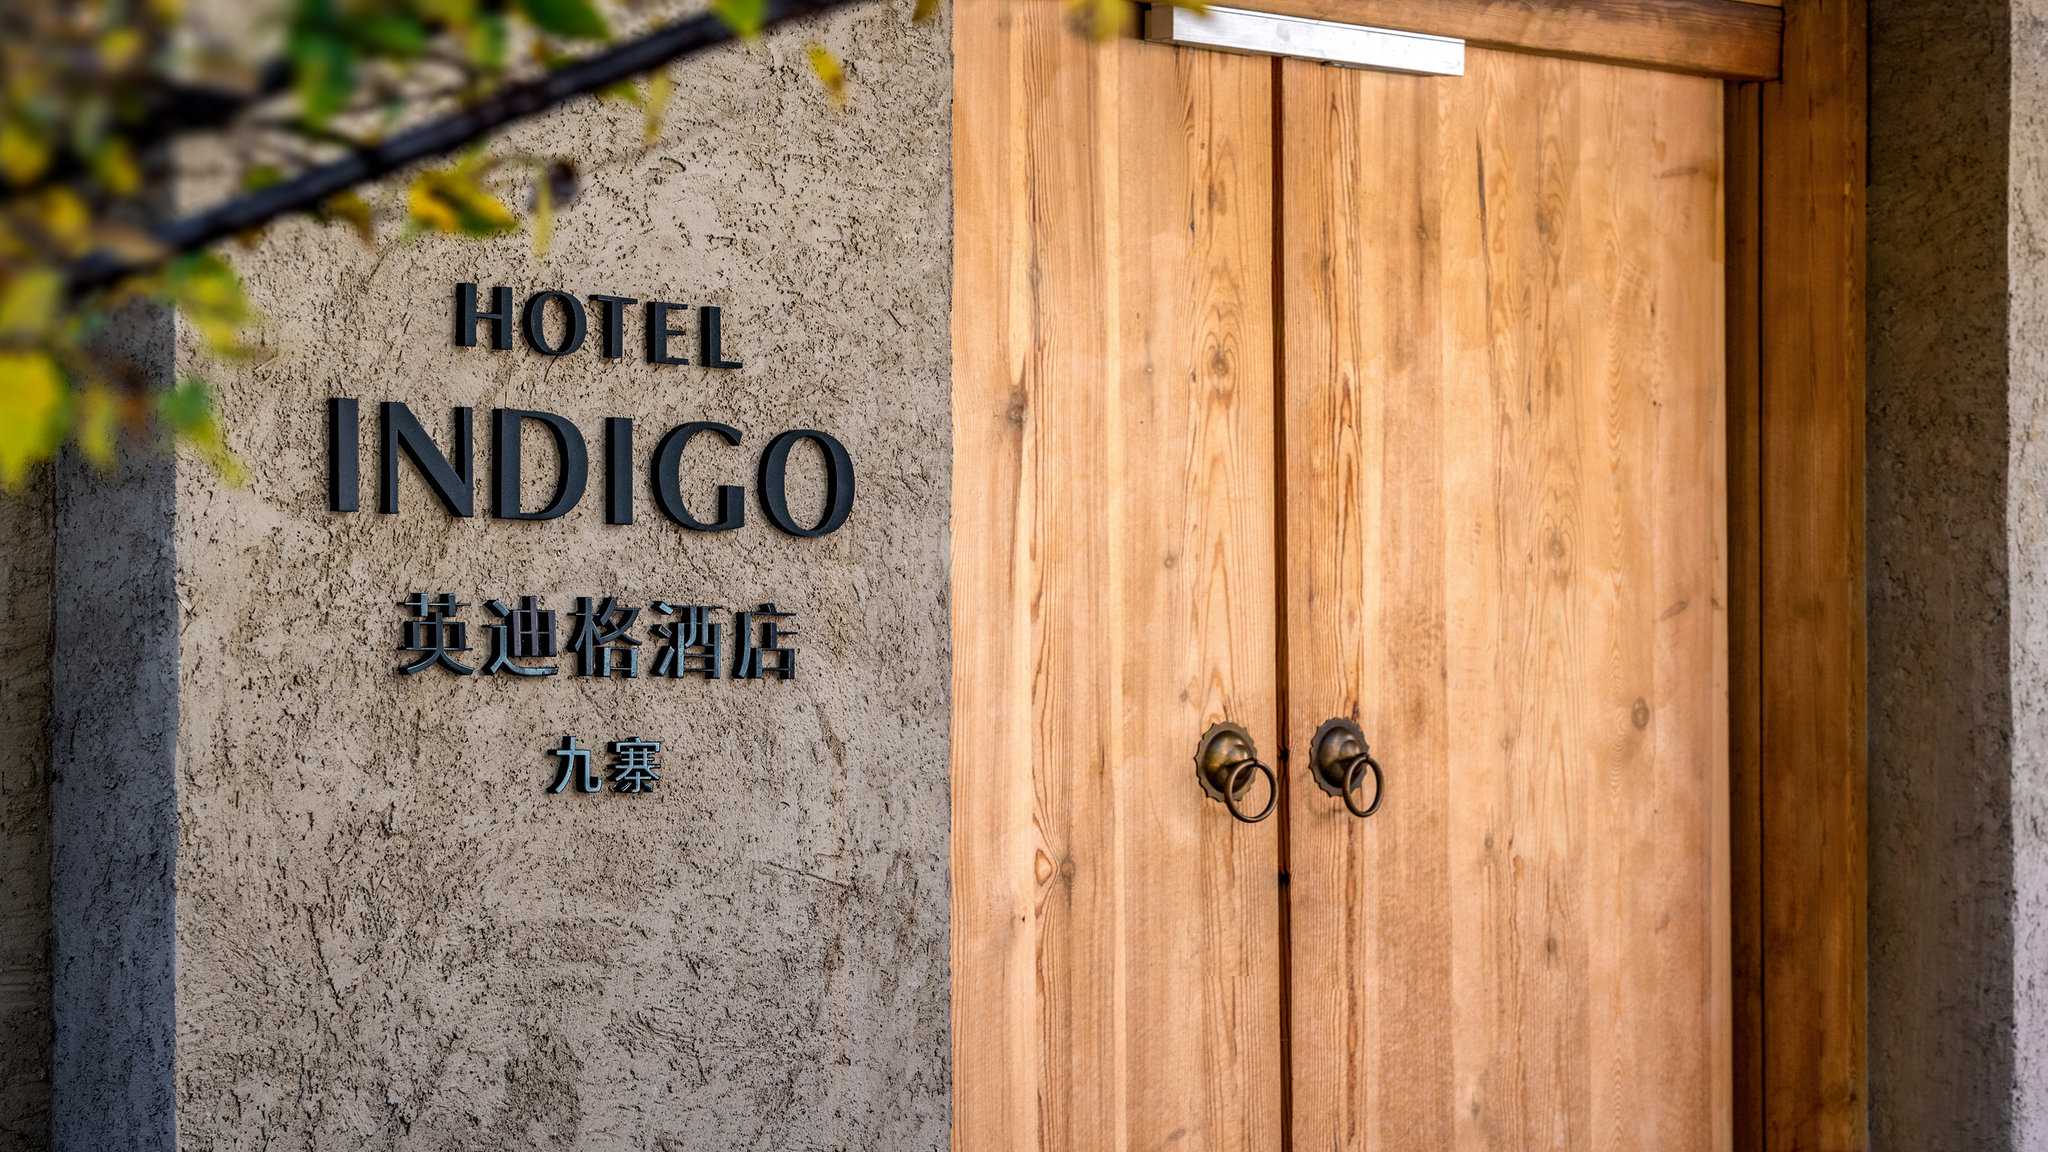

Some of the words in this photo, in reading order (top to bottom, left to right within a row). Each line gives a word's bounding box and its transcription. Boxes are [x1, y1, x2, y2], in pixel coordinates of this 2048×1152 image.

[454, 282, 743, 369] HOTEL
[328, 397, 856, 538] INDIGO
[398, 592, 798, 680] 英迪格酒店
[546, 735, 663, 795] 九寨
